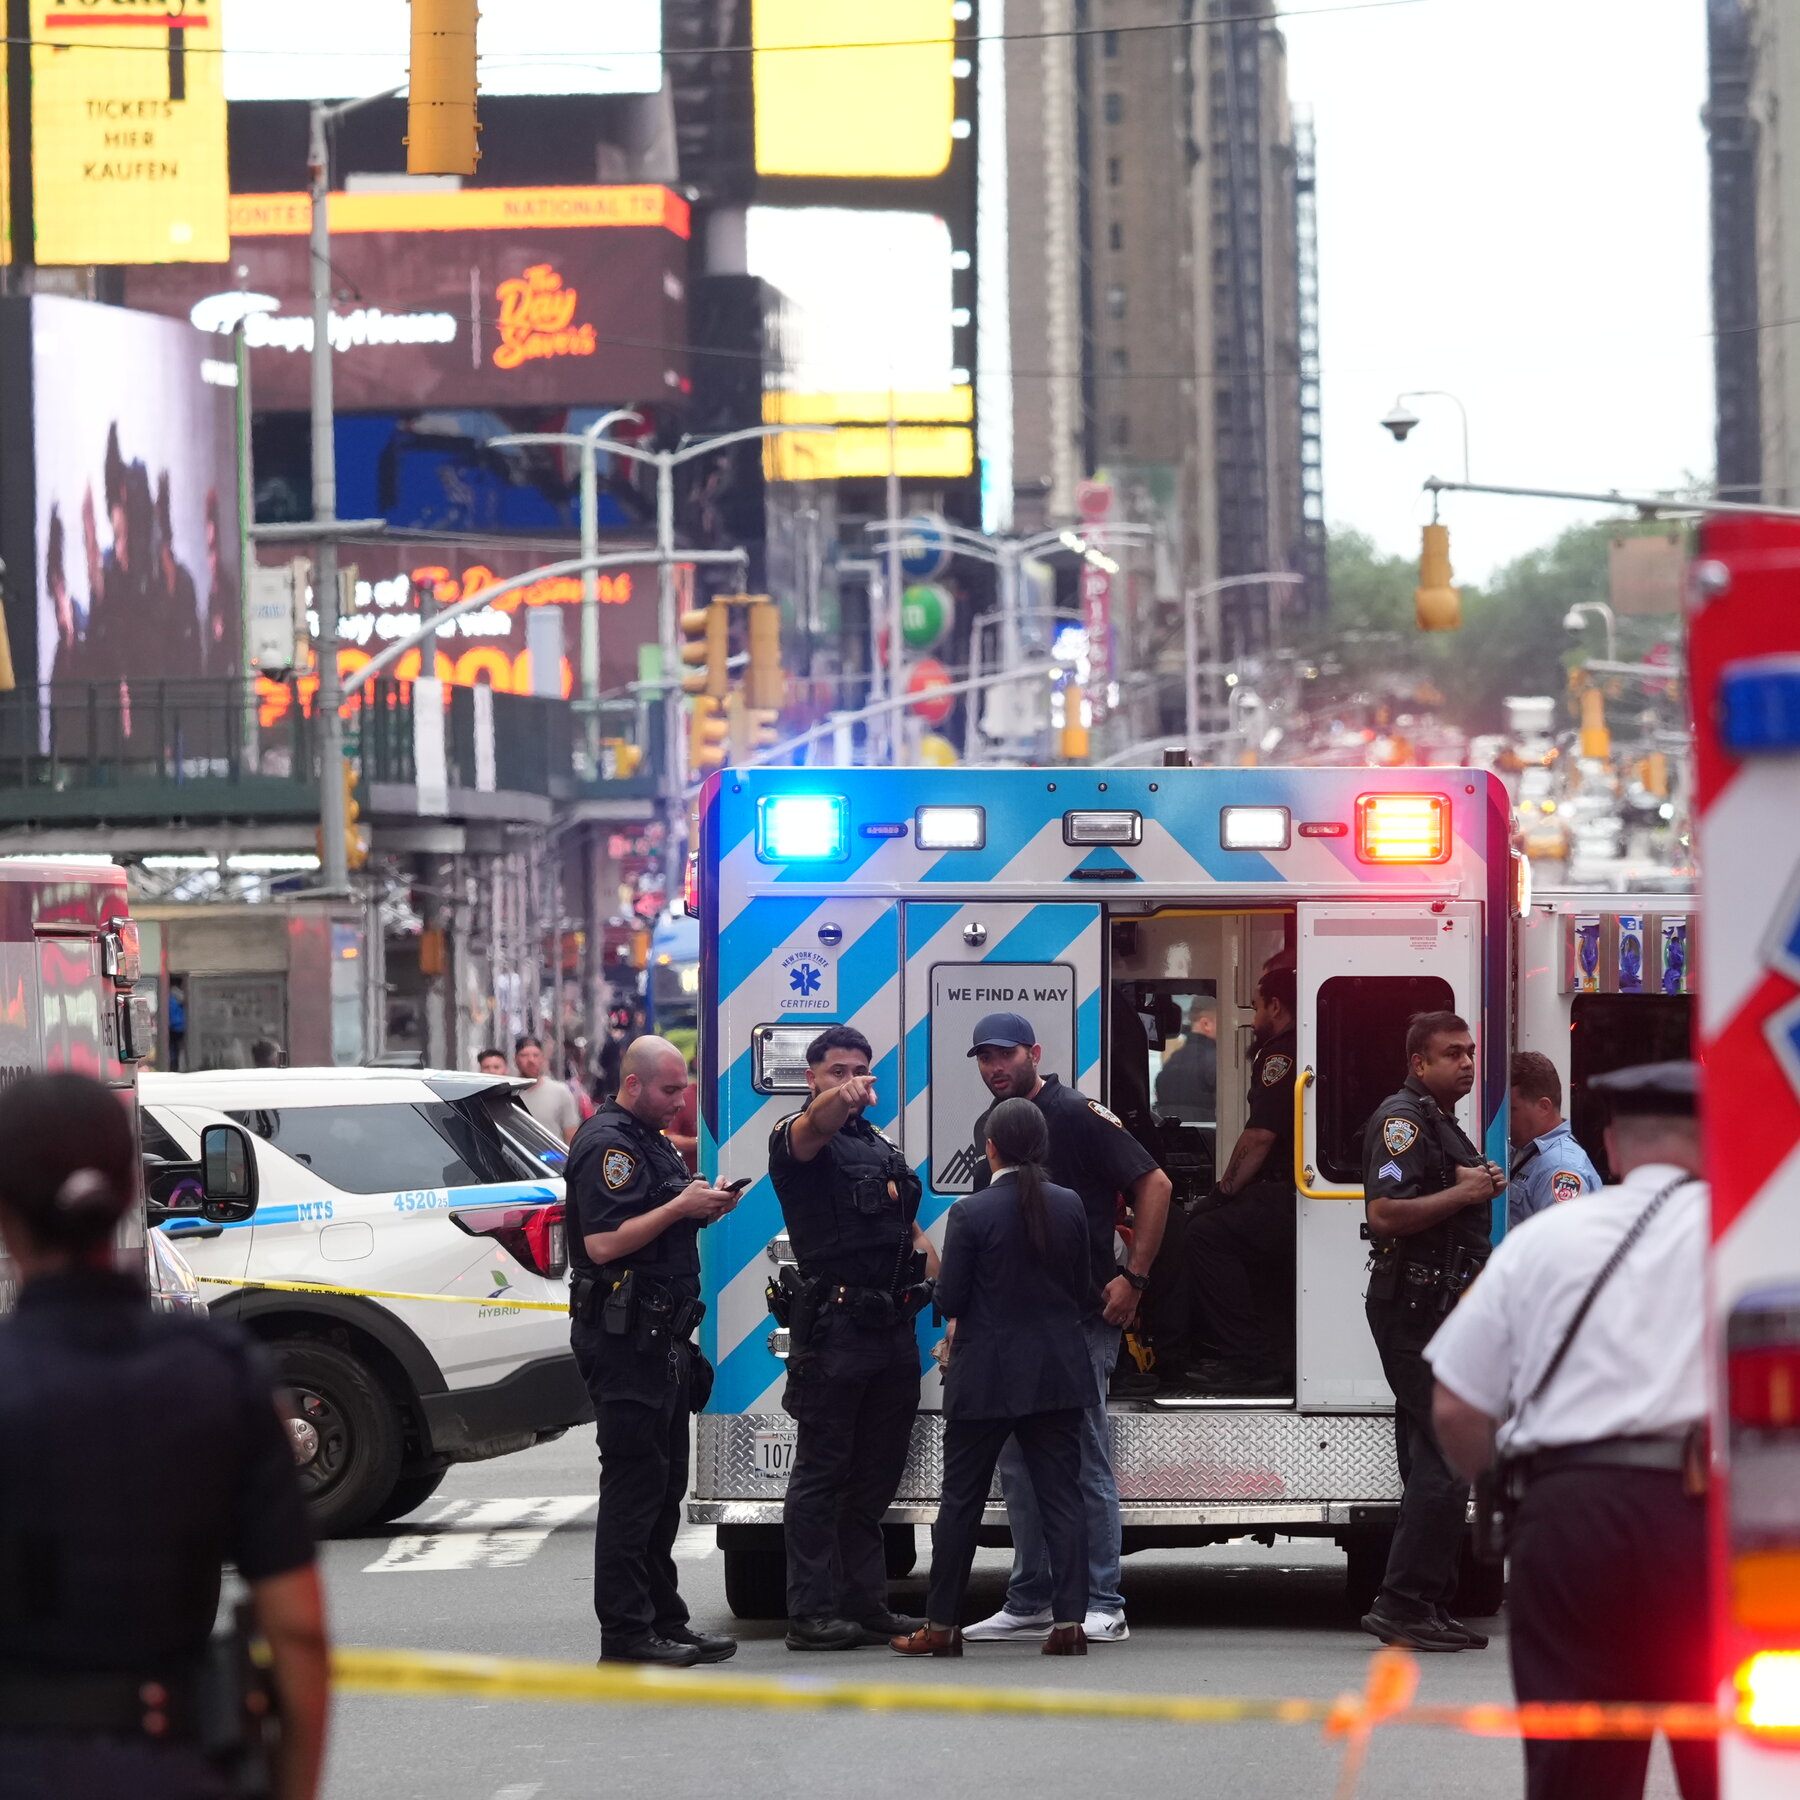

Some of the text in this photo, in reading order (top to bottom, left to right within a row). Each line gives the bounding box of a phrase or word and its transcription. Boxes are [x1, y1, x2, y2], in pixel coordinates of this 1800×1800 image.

[86, 100, 174, 119] TICKETS
[104, 131, 154, 148] HIER
[83, 162, 179, 181] KAUFEN
[504, 198, 620, 219] NATIONAL
[496, 278, 577, 335] Day
[781, 954, 795, 968] NEW
[813, 953, 830, 968] STATE
[780, 1000, 830, 1008] CERTIFIED
[948, 988, 1068, 1001] WE FIND A WAY
[394, 1191, 448, 1211] 4520 25
[300, 1201, 333, 1221] MTS
[478, 1307, 521, 1318] HYBRID
[763, 1443, 797, 1469] 107
